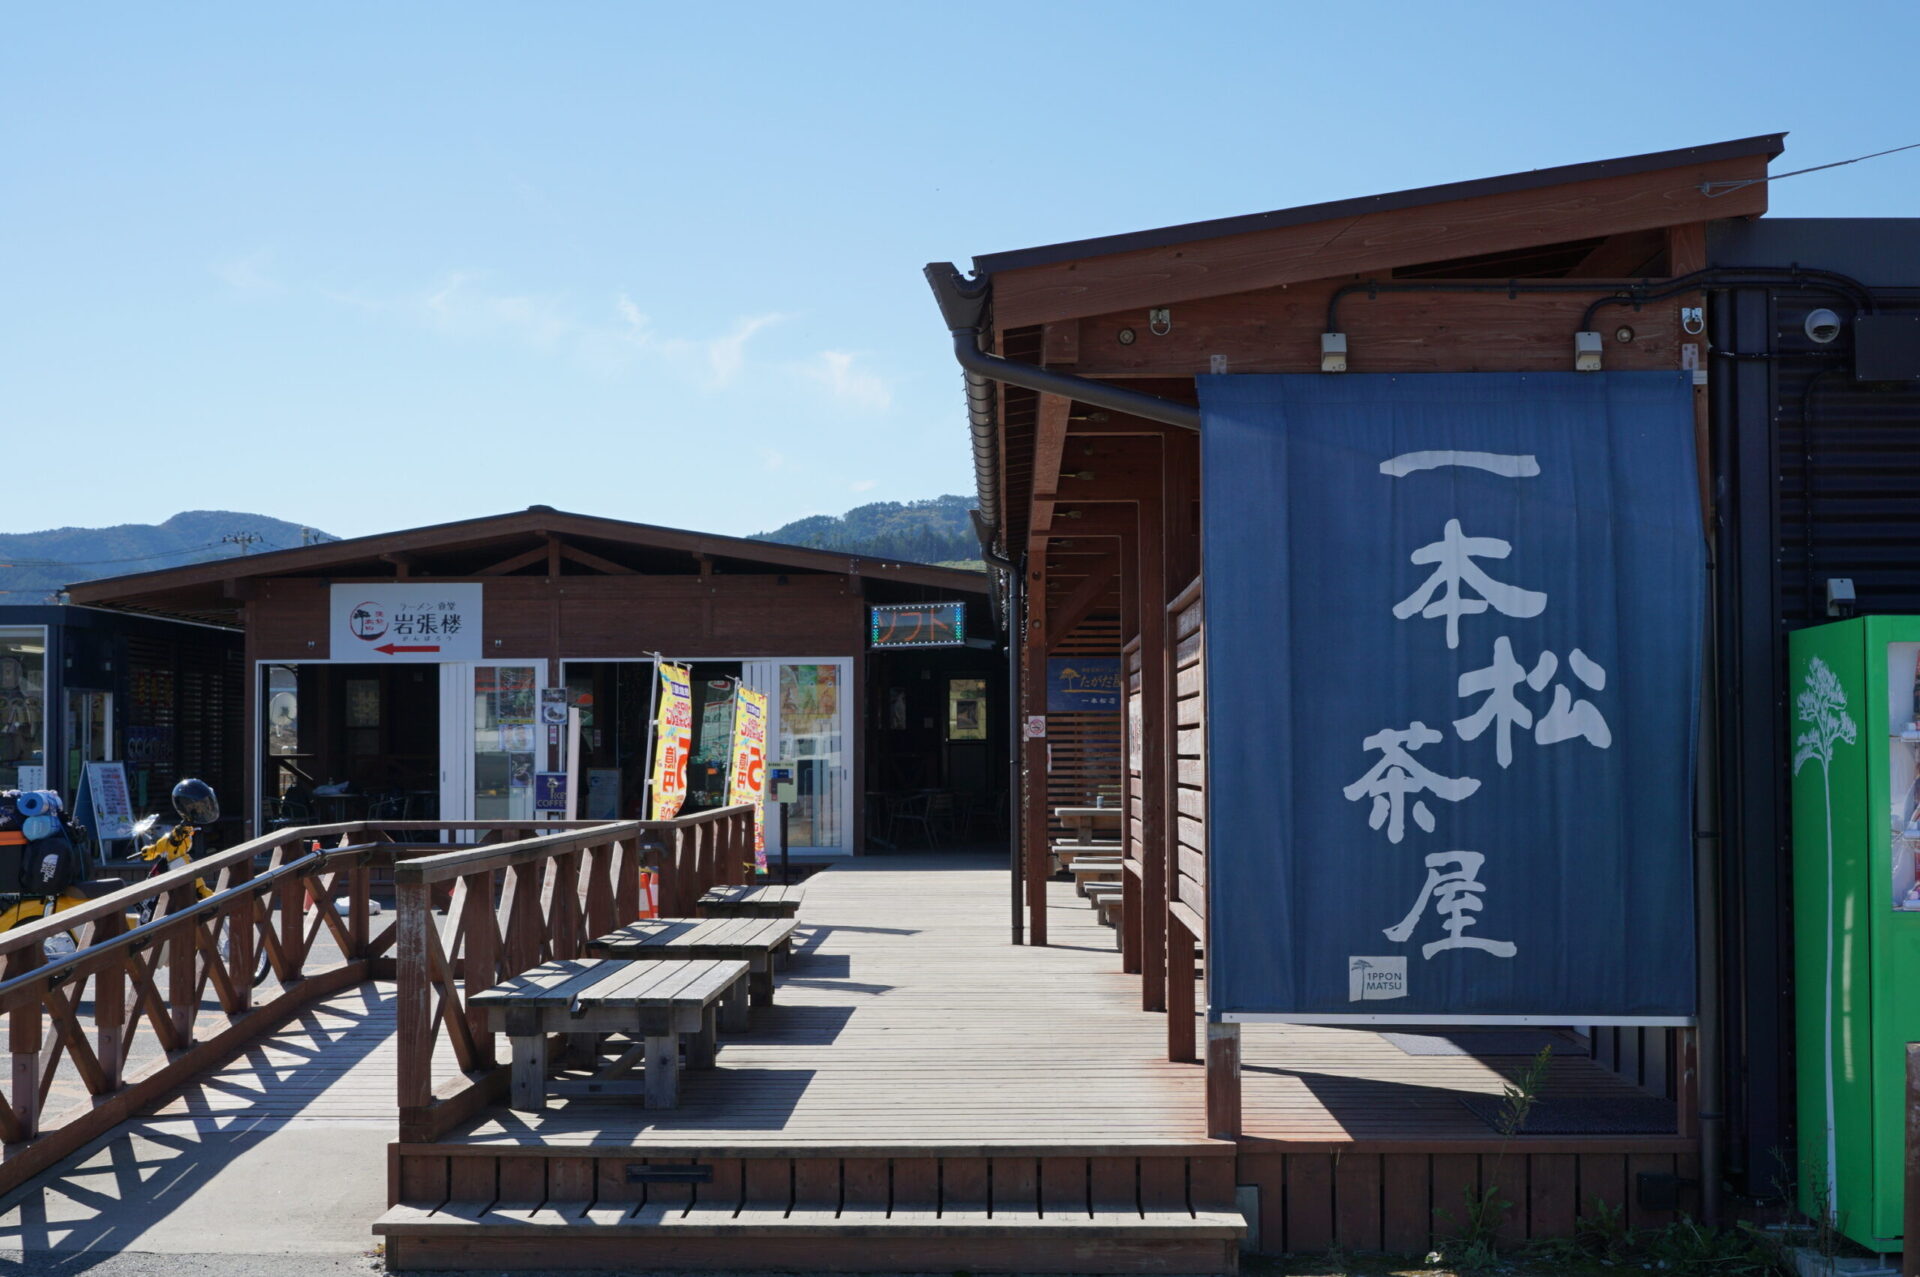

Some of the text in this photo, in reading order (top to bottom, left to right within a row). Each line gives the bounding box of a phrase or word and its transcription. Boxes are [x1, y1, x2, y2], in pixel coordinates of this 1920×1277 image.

[393, 613, 463, 635] 岩張楼
[878, 608, 949, 643] ソフト
[1342, 449, 1612, 960] 一本松茶屋
[1366, 982, 1402, 990] MATSU
